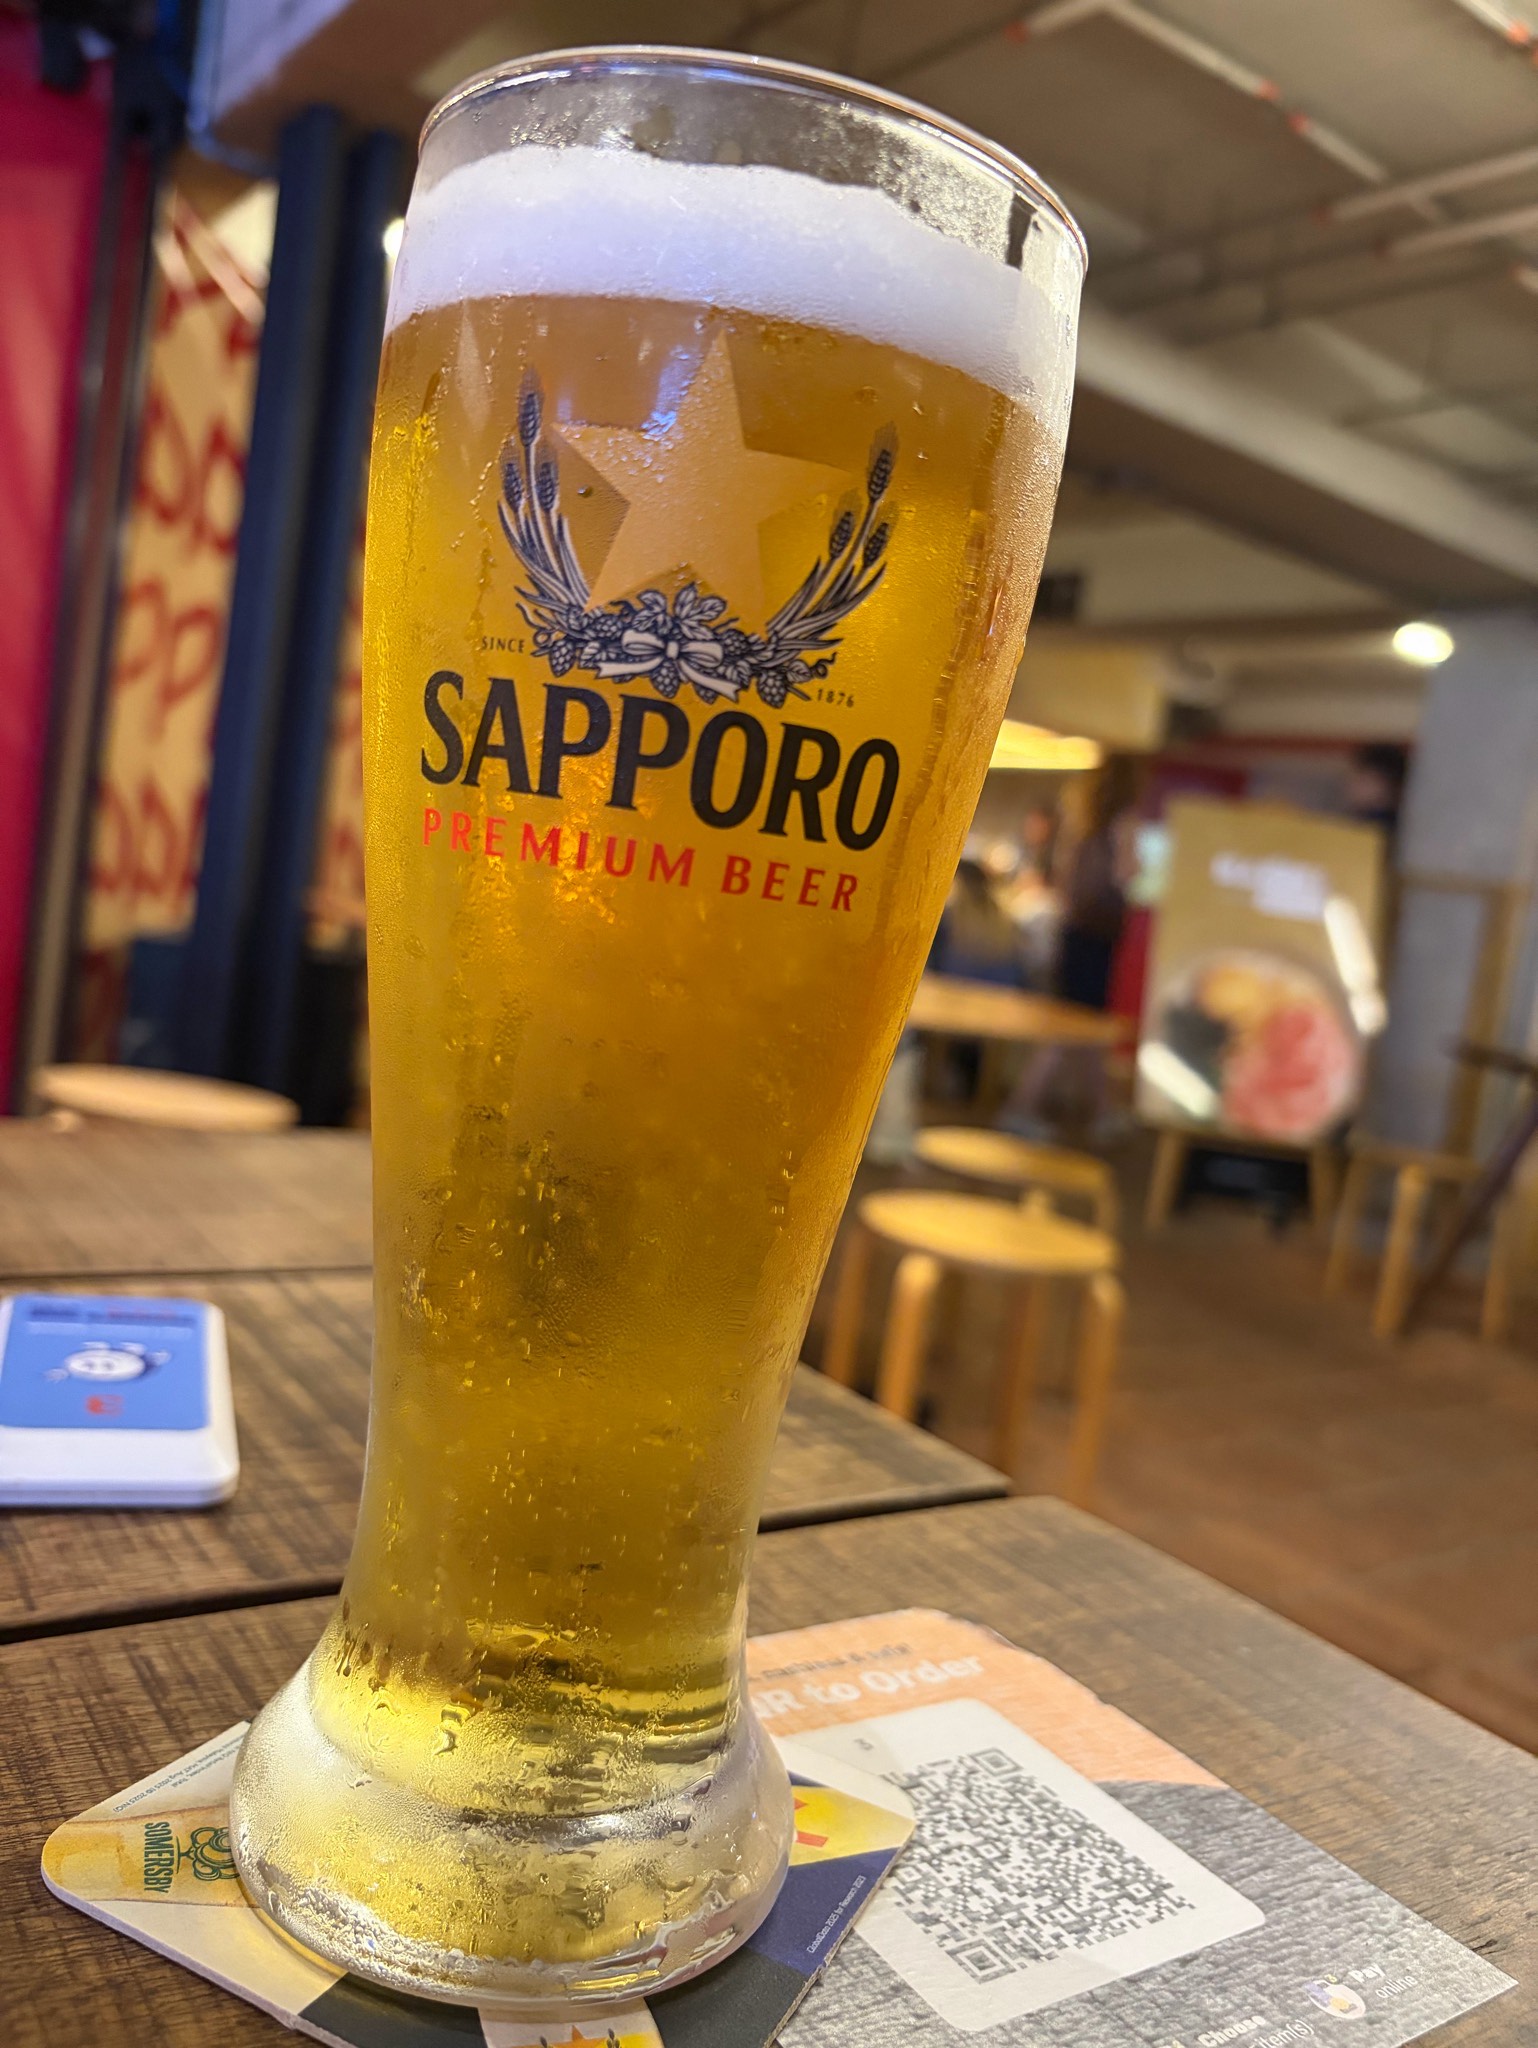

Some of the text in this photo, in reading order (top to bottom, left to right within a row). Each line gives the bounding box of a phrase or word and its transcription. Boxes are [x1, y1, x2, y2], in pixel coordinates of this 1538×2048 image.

[481, 635, 526, 654] SINCE
[817, 688, 855, 709] 1876
[421, 670, 899, 851] SAPPORO
[422, 807, 859, 912] PREMIUM BEER
[749, 1687, 806, 1719] R
[803, 1682, 861, 1706] to
[858, 1655, 985, 1695] Order
[129, 1791, 147, 1805] 2025
[144, 1821, 174, 1893] SOMERSBY
[1348, 1962, 1386, 1984] Pay
[1375, 1976, 1418, 1998] online
[1198, 2015, 1266, 2048] Choose
